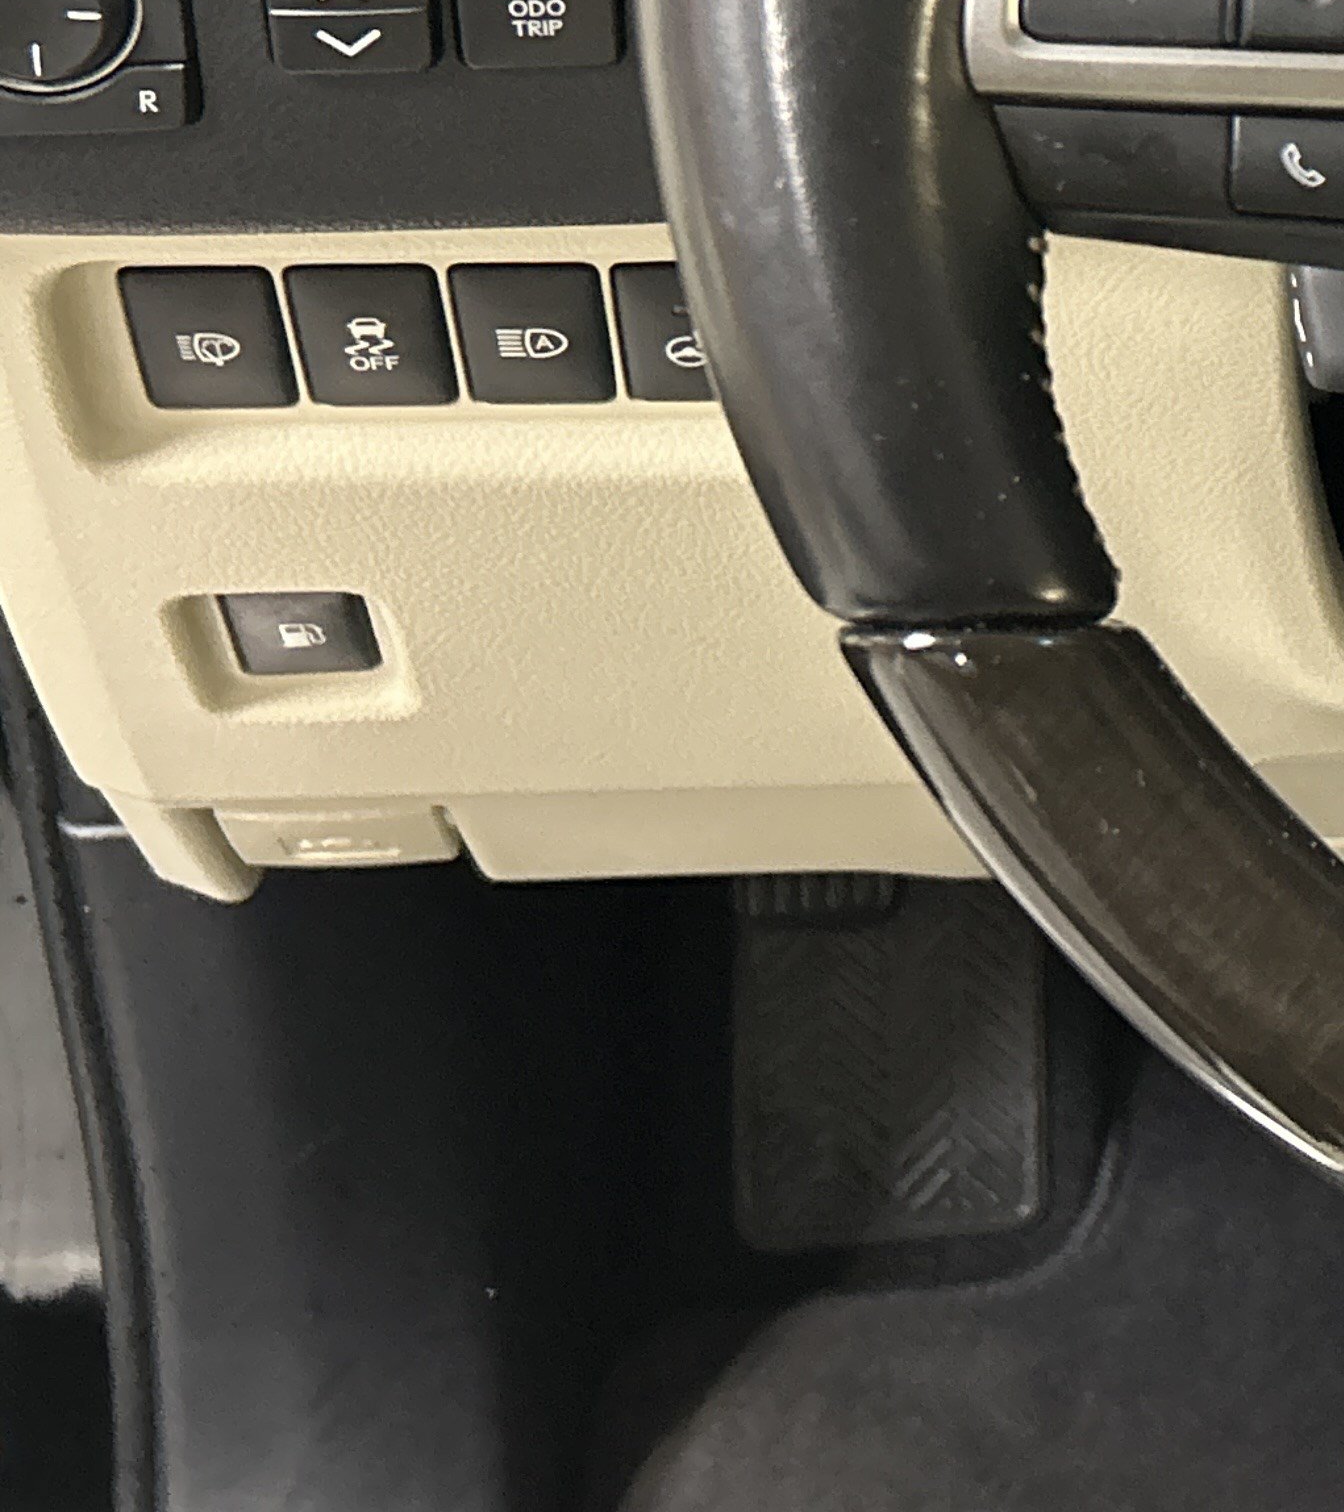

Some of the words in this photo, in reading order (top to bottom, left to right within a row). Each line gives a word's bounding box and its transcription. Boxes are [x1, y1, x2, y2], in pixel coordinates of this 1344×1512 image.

[511, 19, 564, 37] TRIP
[138, 90, 160, 113] R
[349, 354, 400, 372] OFF
